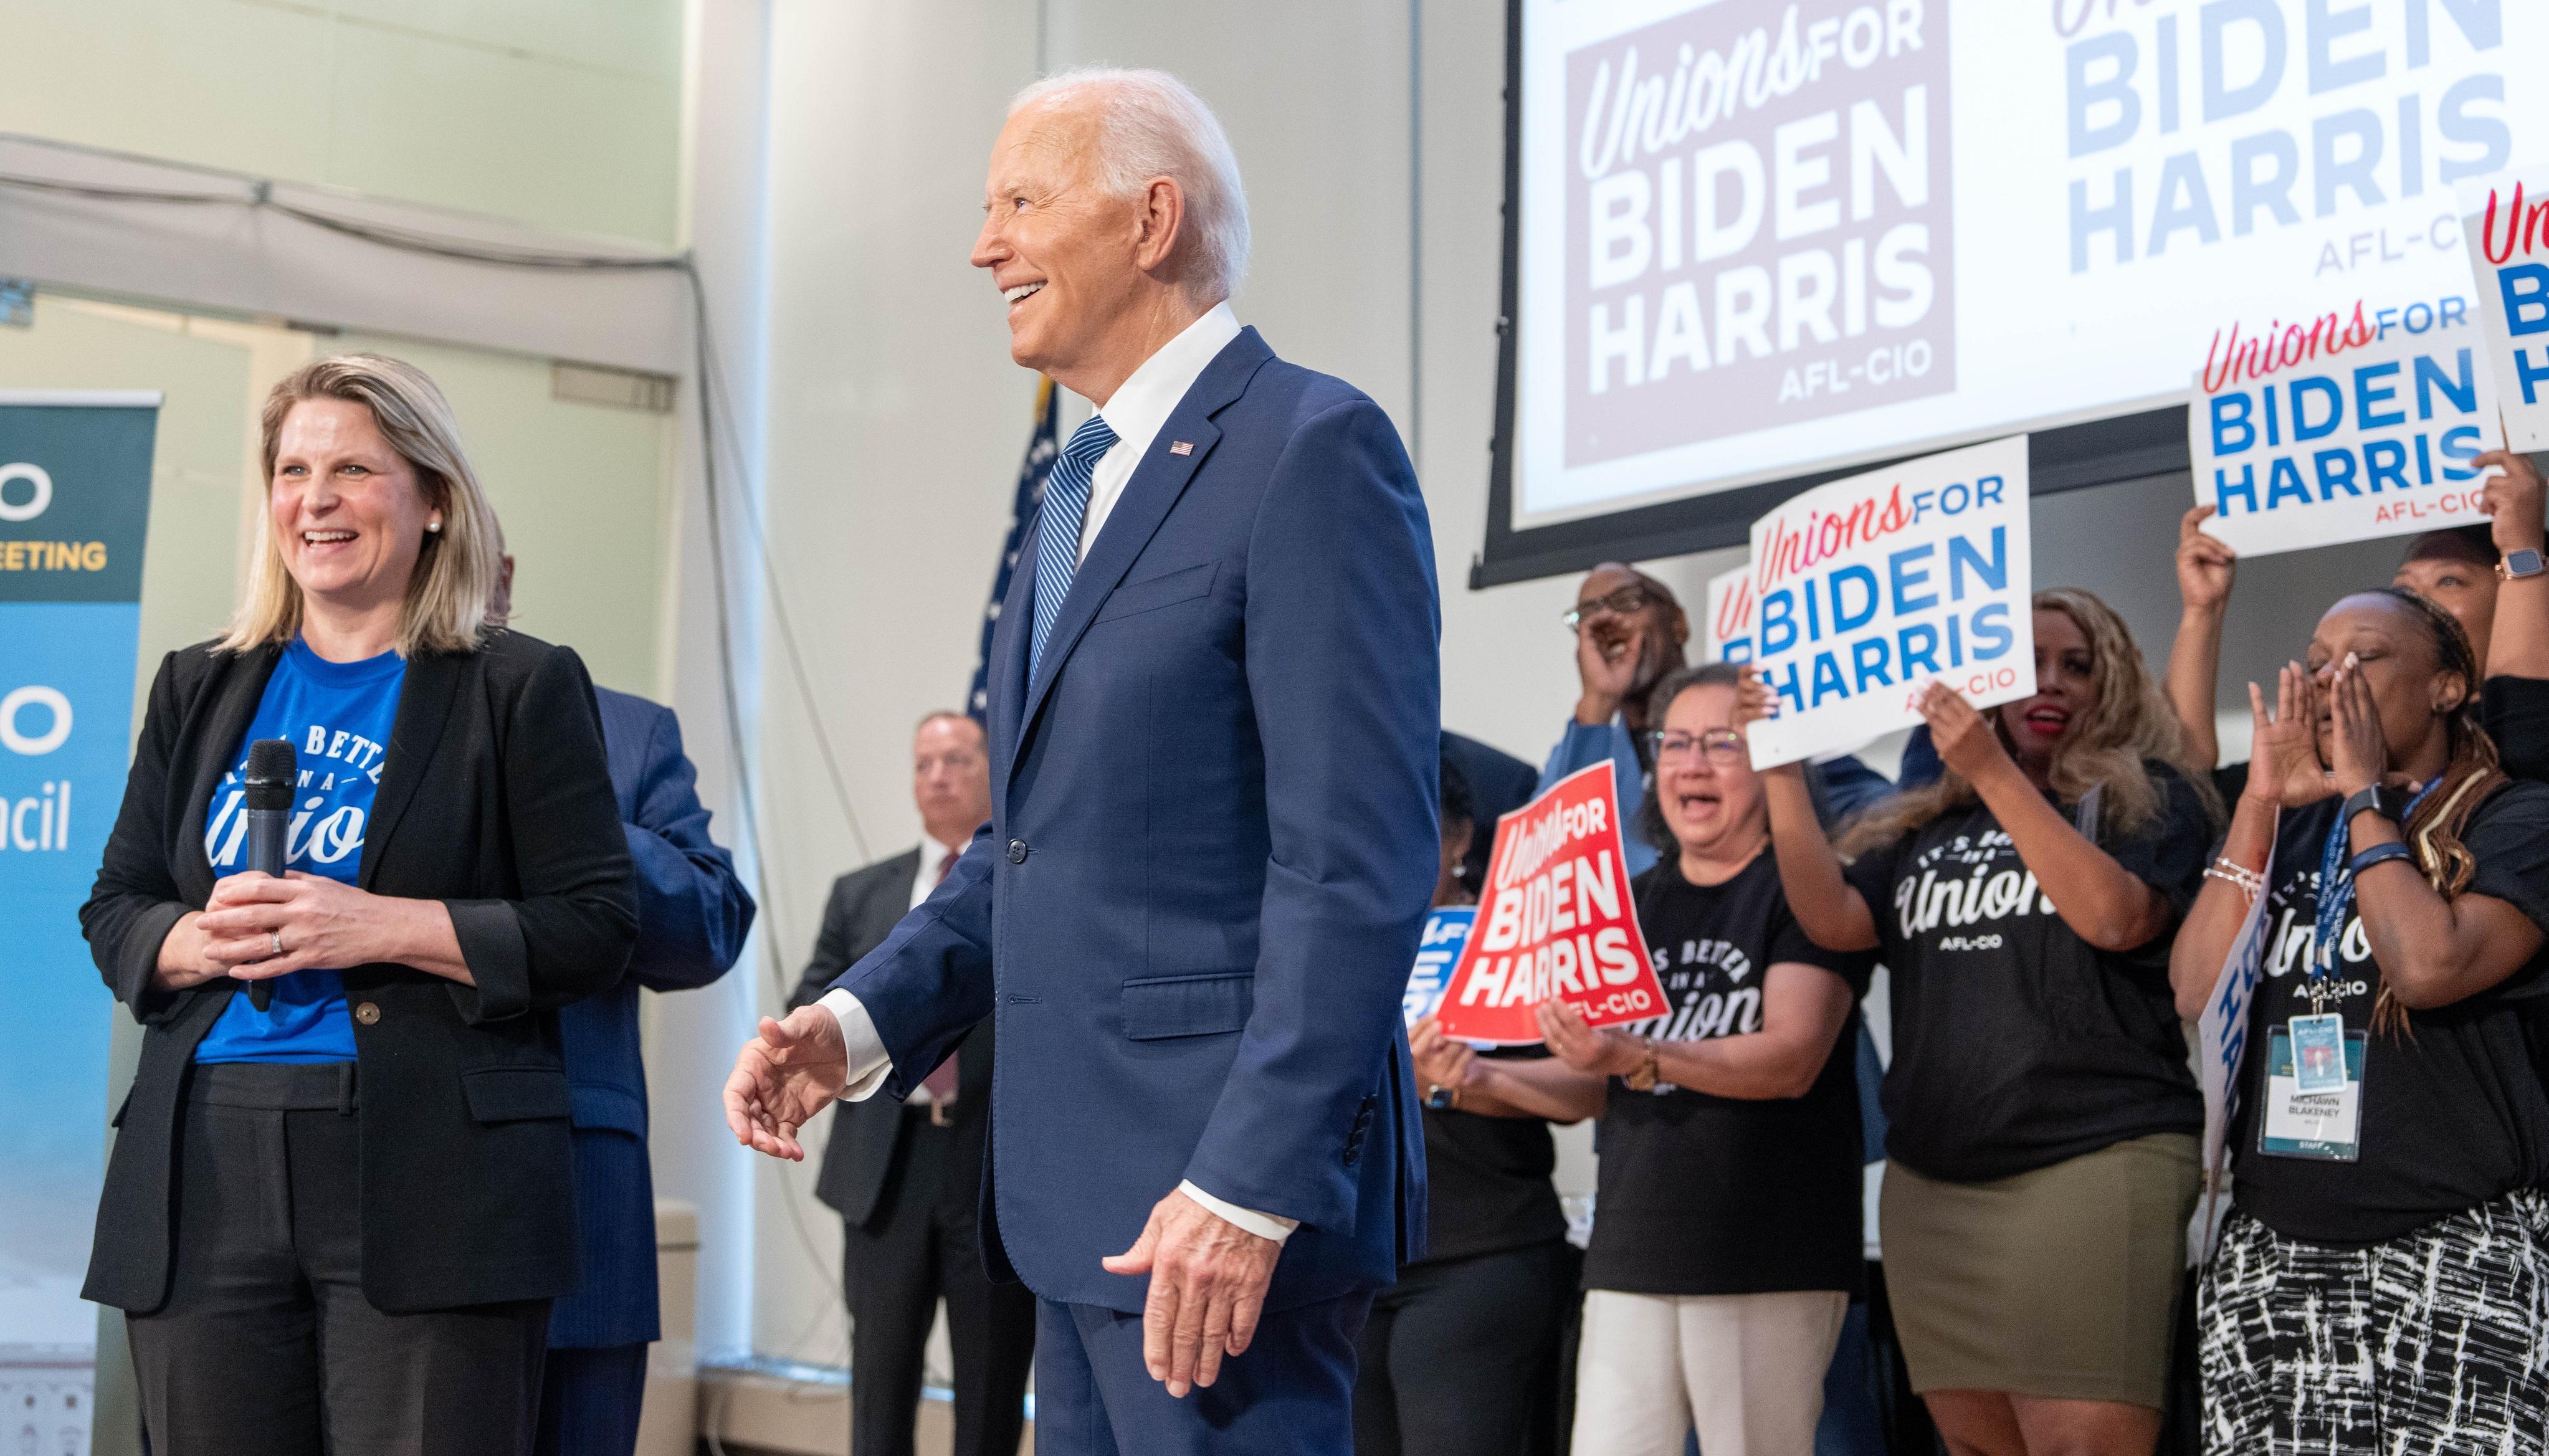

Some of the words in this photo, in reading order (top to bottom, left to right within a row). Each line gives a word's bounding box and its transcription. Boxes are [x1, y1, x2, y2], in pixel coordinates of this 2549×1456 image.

[1579, 4, 1812, 181] Unions
[1809, 0, 1924, 82] FOR
[1589, 83, 1930, 291] BIDEN
[2069, 73, 2512, 275] HARRIS
[2314, 214, 2458, 278] AFL-C
[1589, 222, 1934, 396] HARRIS
[2203, 299, 2375, 394] Unions
[2375, 296, 2467, 341] FOR
[1778, 340, 1933, 404] AFL-CIO
[2210, 347, 2477, 456] BIDEN
[2214, 425, 2485, 517] HARRIS
[1758, 482, 1912, 596] Unions
[1911, 475, 2004, 525] FOR
[1761, 524, 2008, 658] BIDEN
[1763, 602, 2014, 720] HARRIS
[320, 772, 335, 791] A
[1495, 798, 1568, 890] Unions
[1563, 797, 1608, 844] FOR
[1481, 849, 1621, 953] BIDEN
[1895, 863, 2056, 940] Union
[1459, 926, 1640, 1008] HARRIS
[1568, 989, 1651, 1020] FL-CIO
[1622, 986, 1763, 1043] nion
